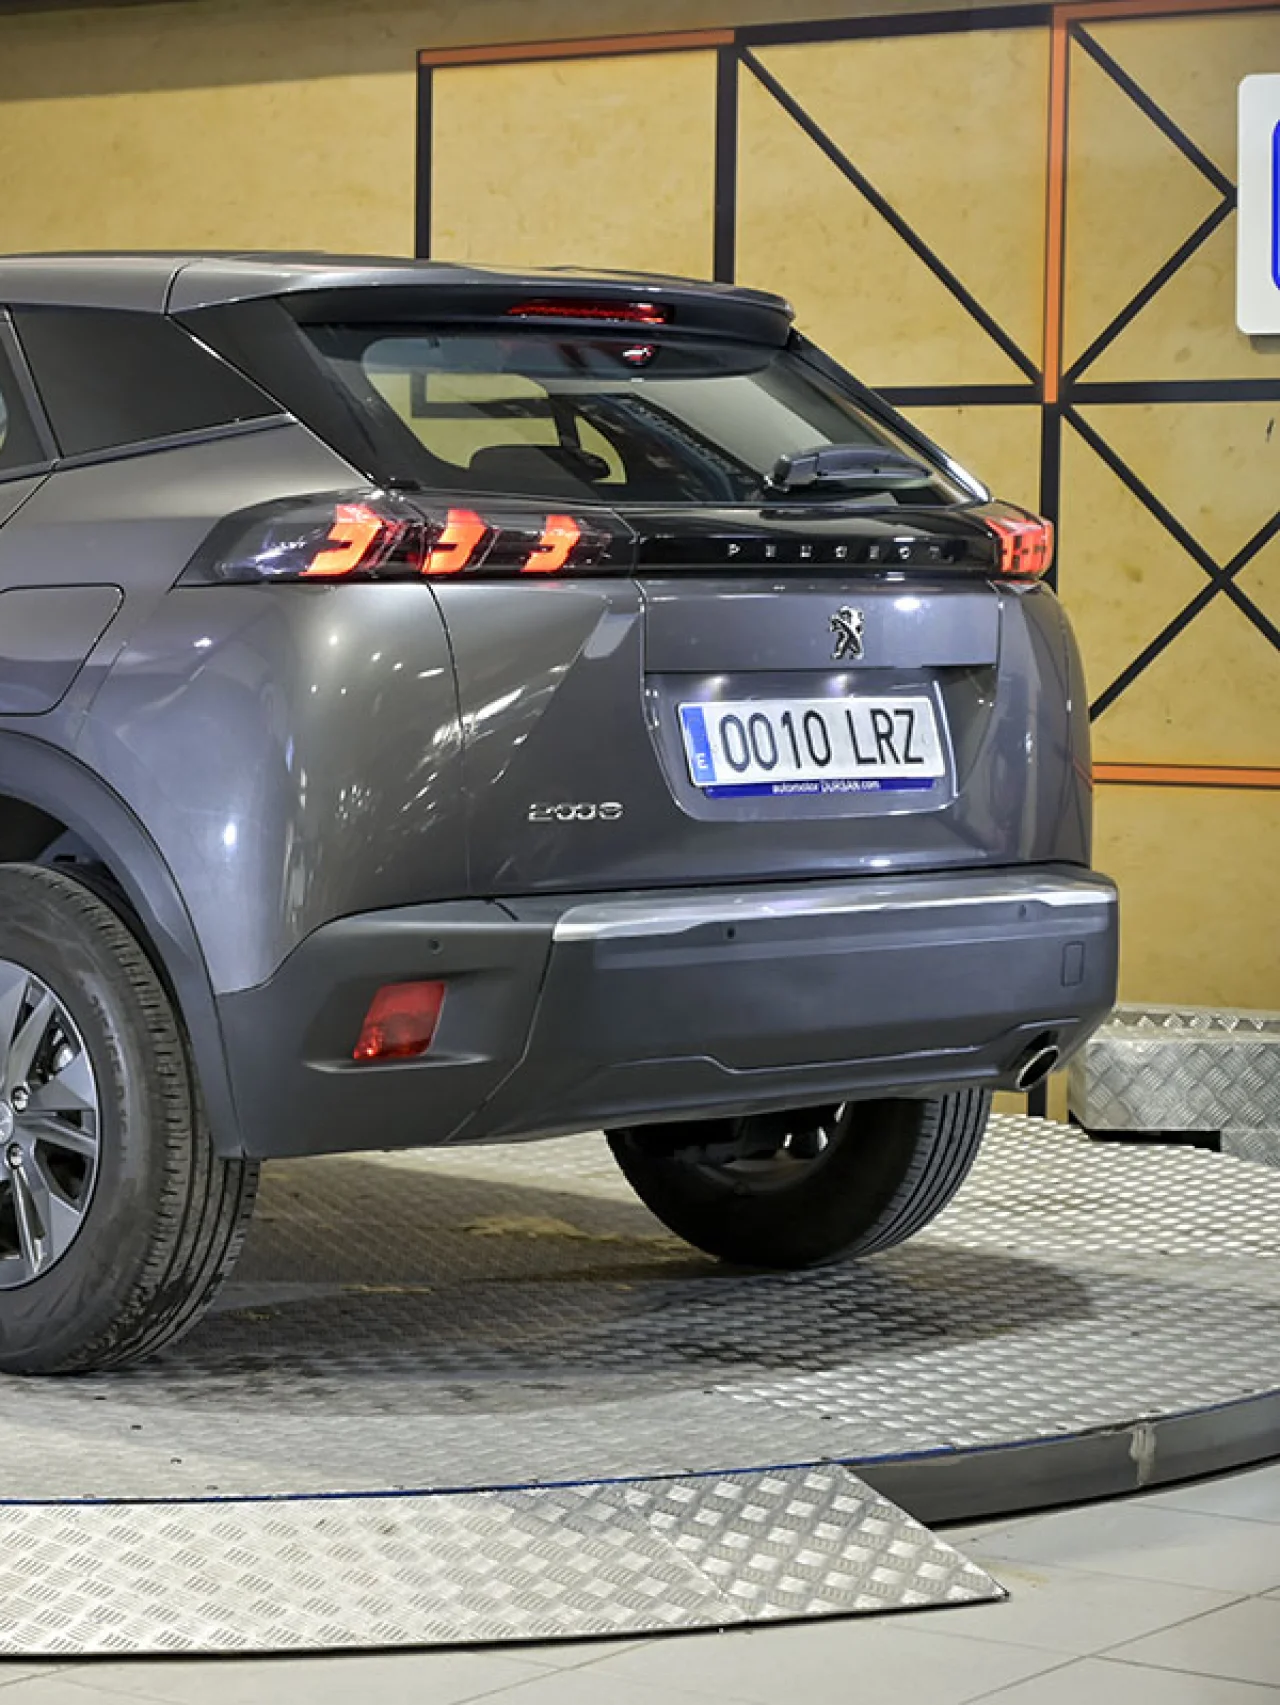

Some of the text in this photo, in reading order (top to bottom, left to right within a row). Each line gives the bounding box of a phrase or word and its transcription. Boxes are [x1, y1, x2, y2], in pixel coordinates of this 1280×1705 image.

[719, 707, 925, 773] 0010 LRZ
[695, 752, 708, 769] E
[528, 801, 624, 823] 2008
